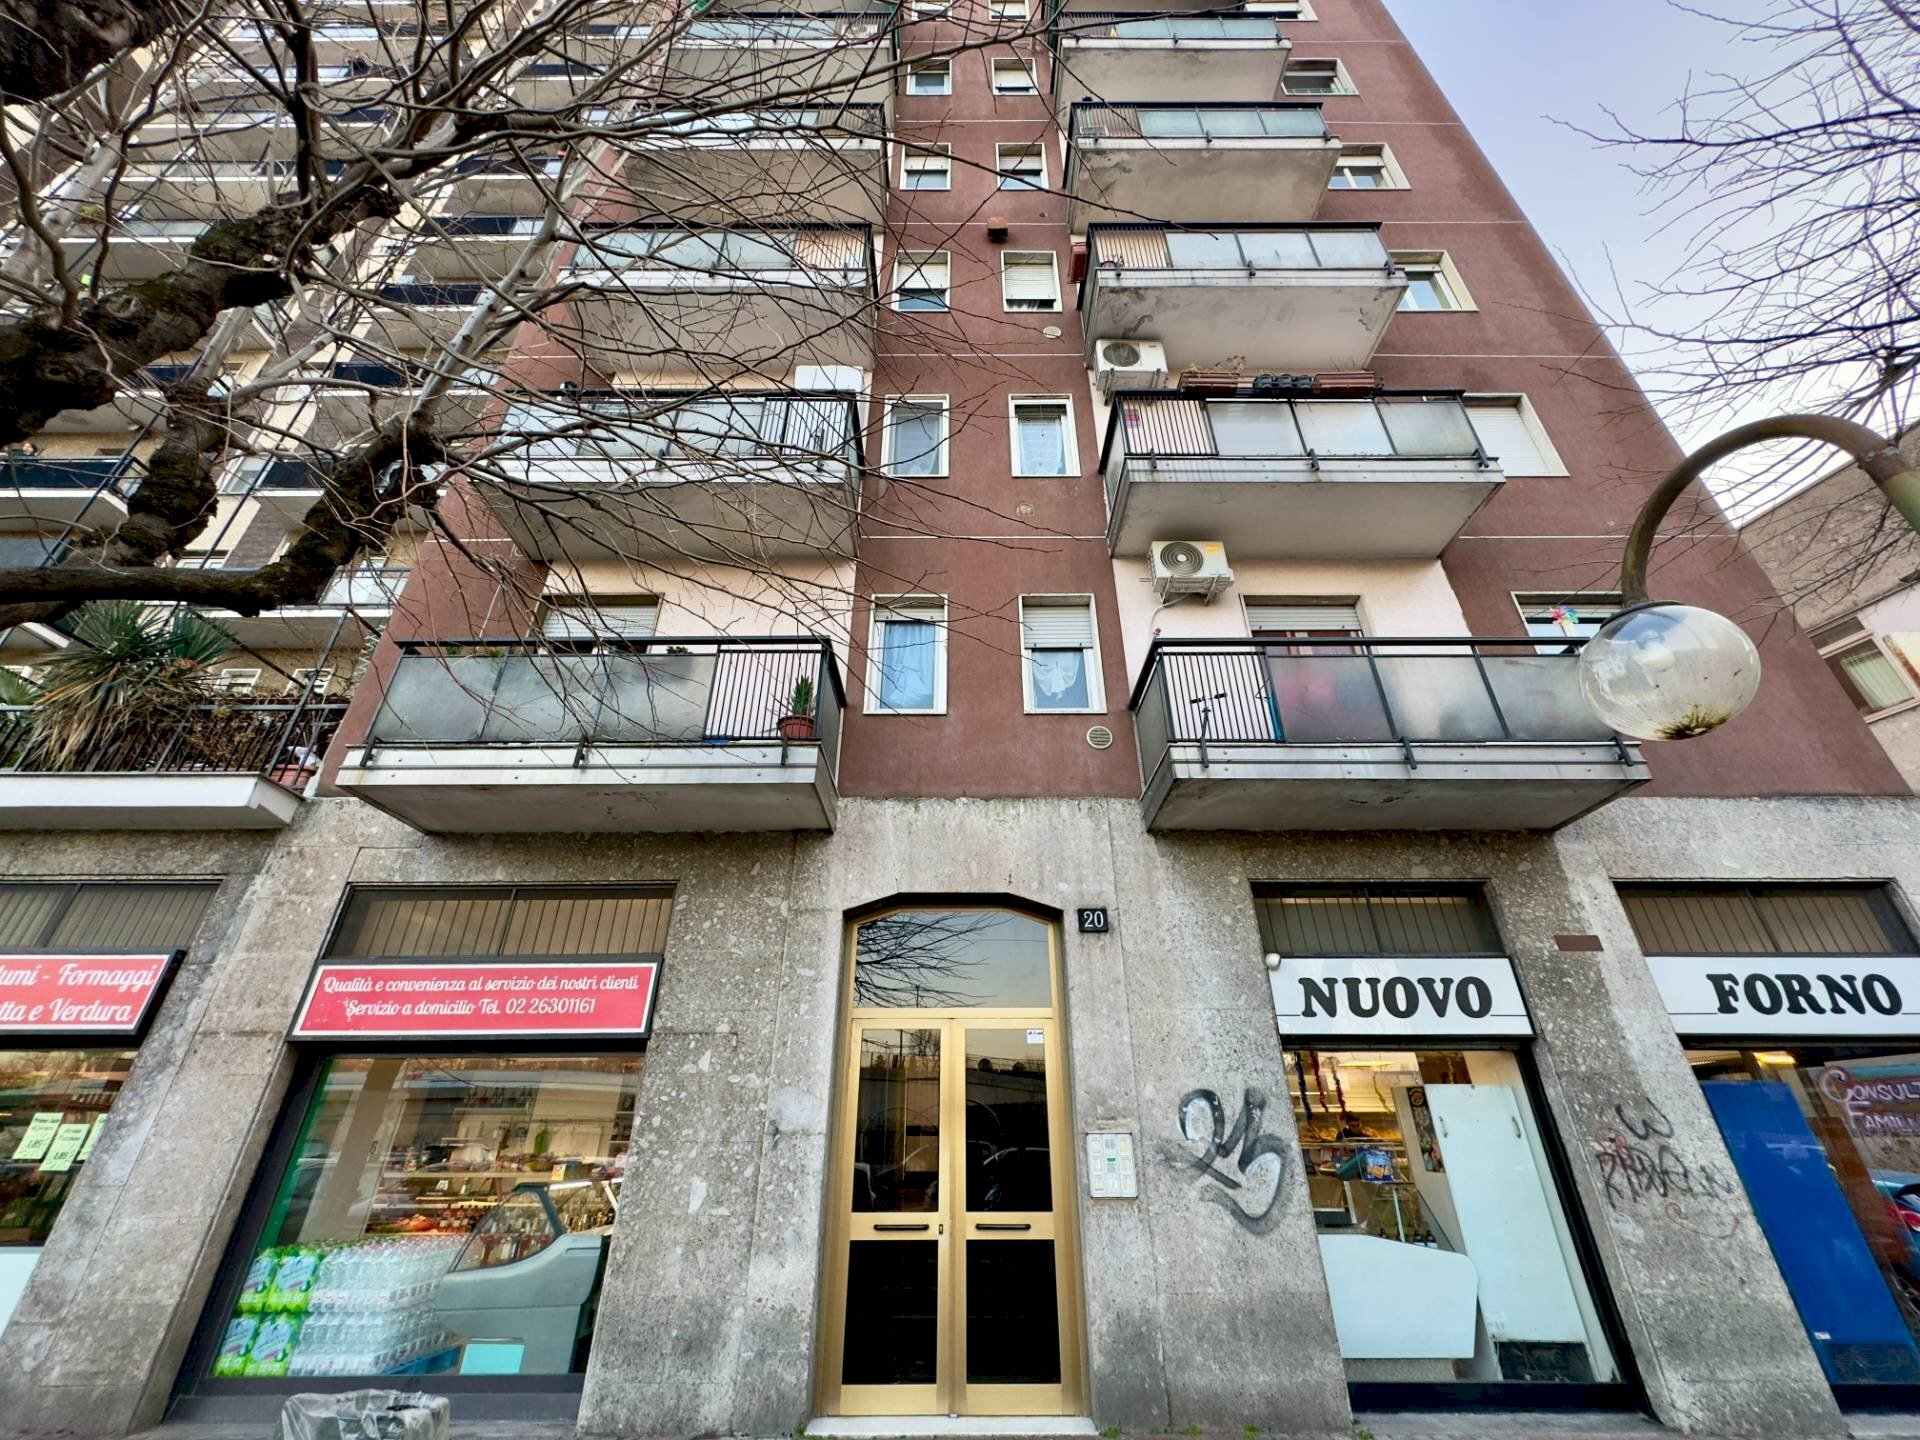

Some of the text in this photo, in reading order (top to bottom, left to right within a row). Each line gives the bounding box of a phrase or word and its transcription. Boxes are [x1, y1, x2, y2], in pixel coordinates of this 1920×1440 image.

[1083, 911, 1104, 928] 20
[57, 963, 158, 993] Formaggi
[323, 974, 640, 993] Qualità e convenienza al servizio dei nostri clienti
[346, 997, 596, 1016] Servizio a domicilio Tel. 02 26301161
[1298, 976, 1493, 1019] NUOVO
[1705, 973, 1903, 1016] FORNO
[28, 1003, 44, 1021] e
[49, 998, 132, 1022] Verdura
